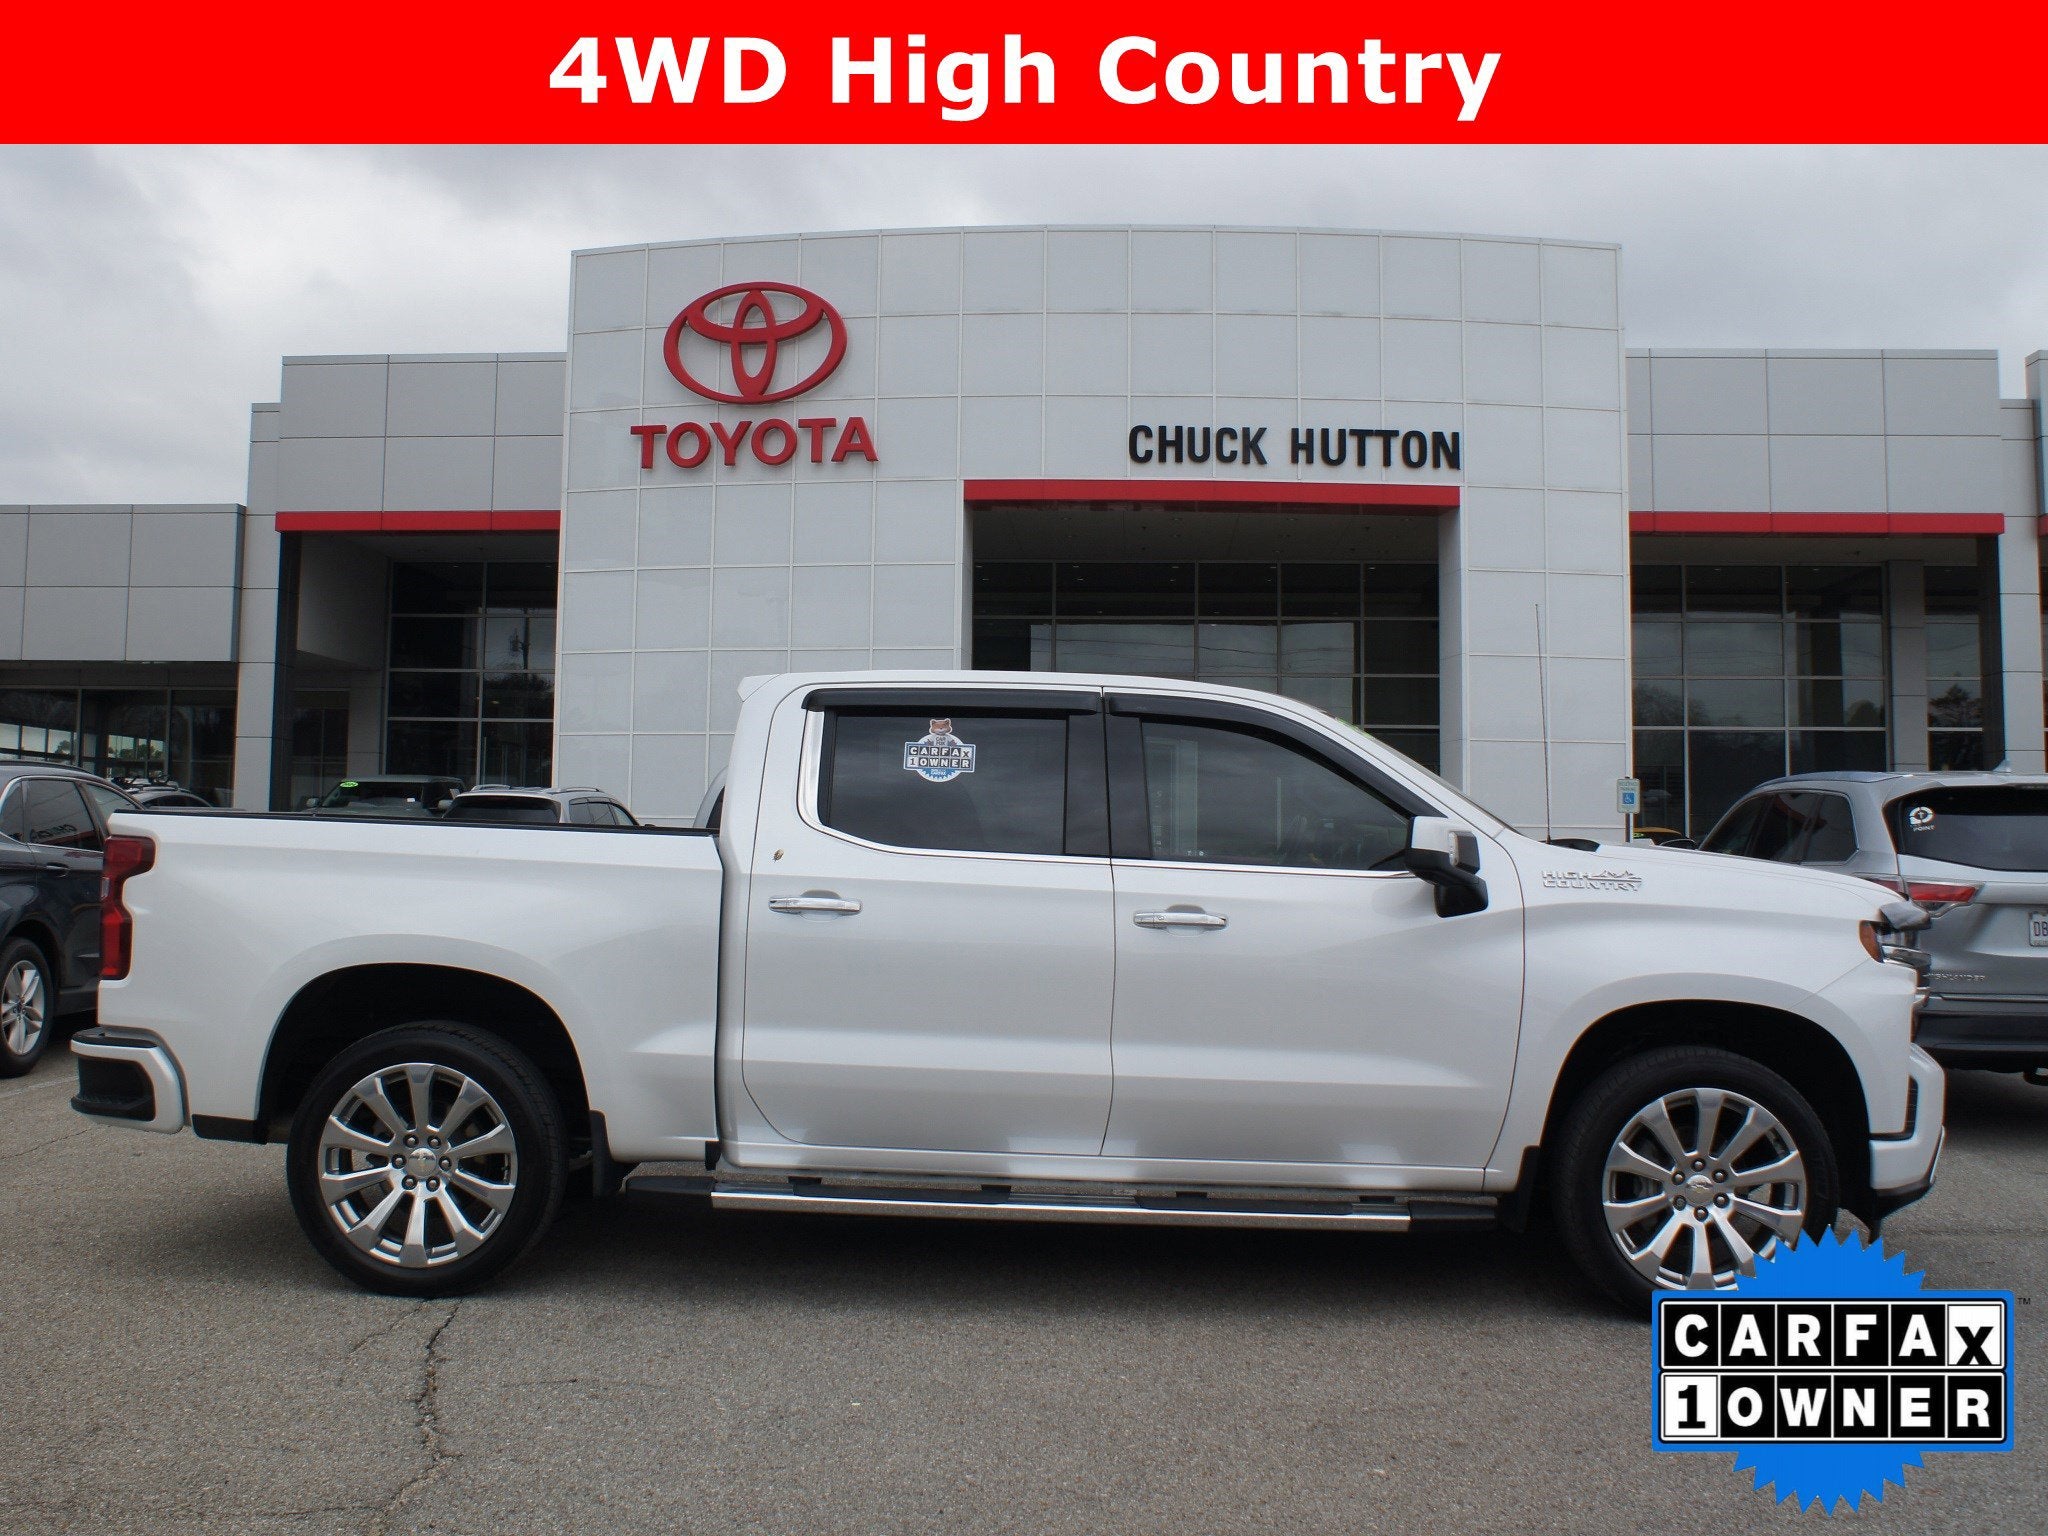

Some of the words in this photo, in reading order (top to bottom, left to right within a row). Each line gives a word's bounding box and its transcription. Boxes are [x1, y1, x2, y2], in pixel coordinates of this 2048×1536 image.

[631, 417, 878, 469] TOYOTA
[1129, 424, 1267, 465] CHUCK
[1291, 428, 1460, 470] HUTTON
[910, 746, 970, 758] CARFAX
[1542, 870, 1592, 880] HIGH
[1543, 880, 1642, 891] COUNTRY
